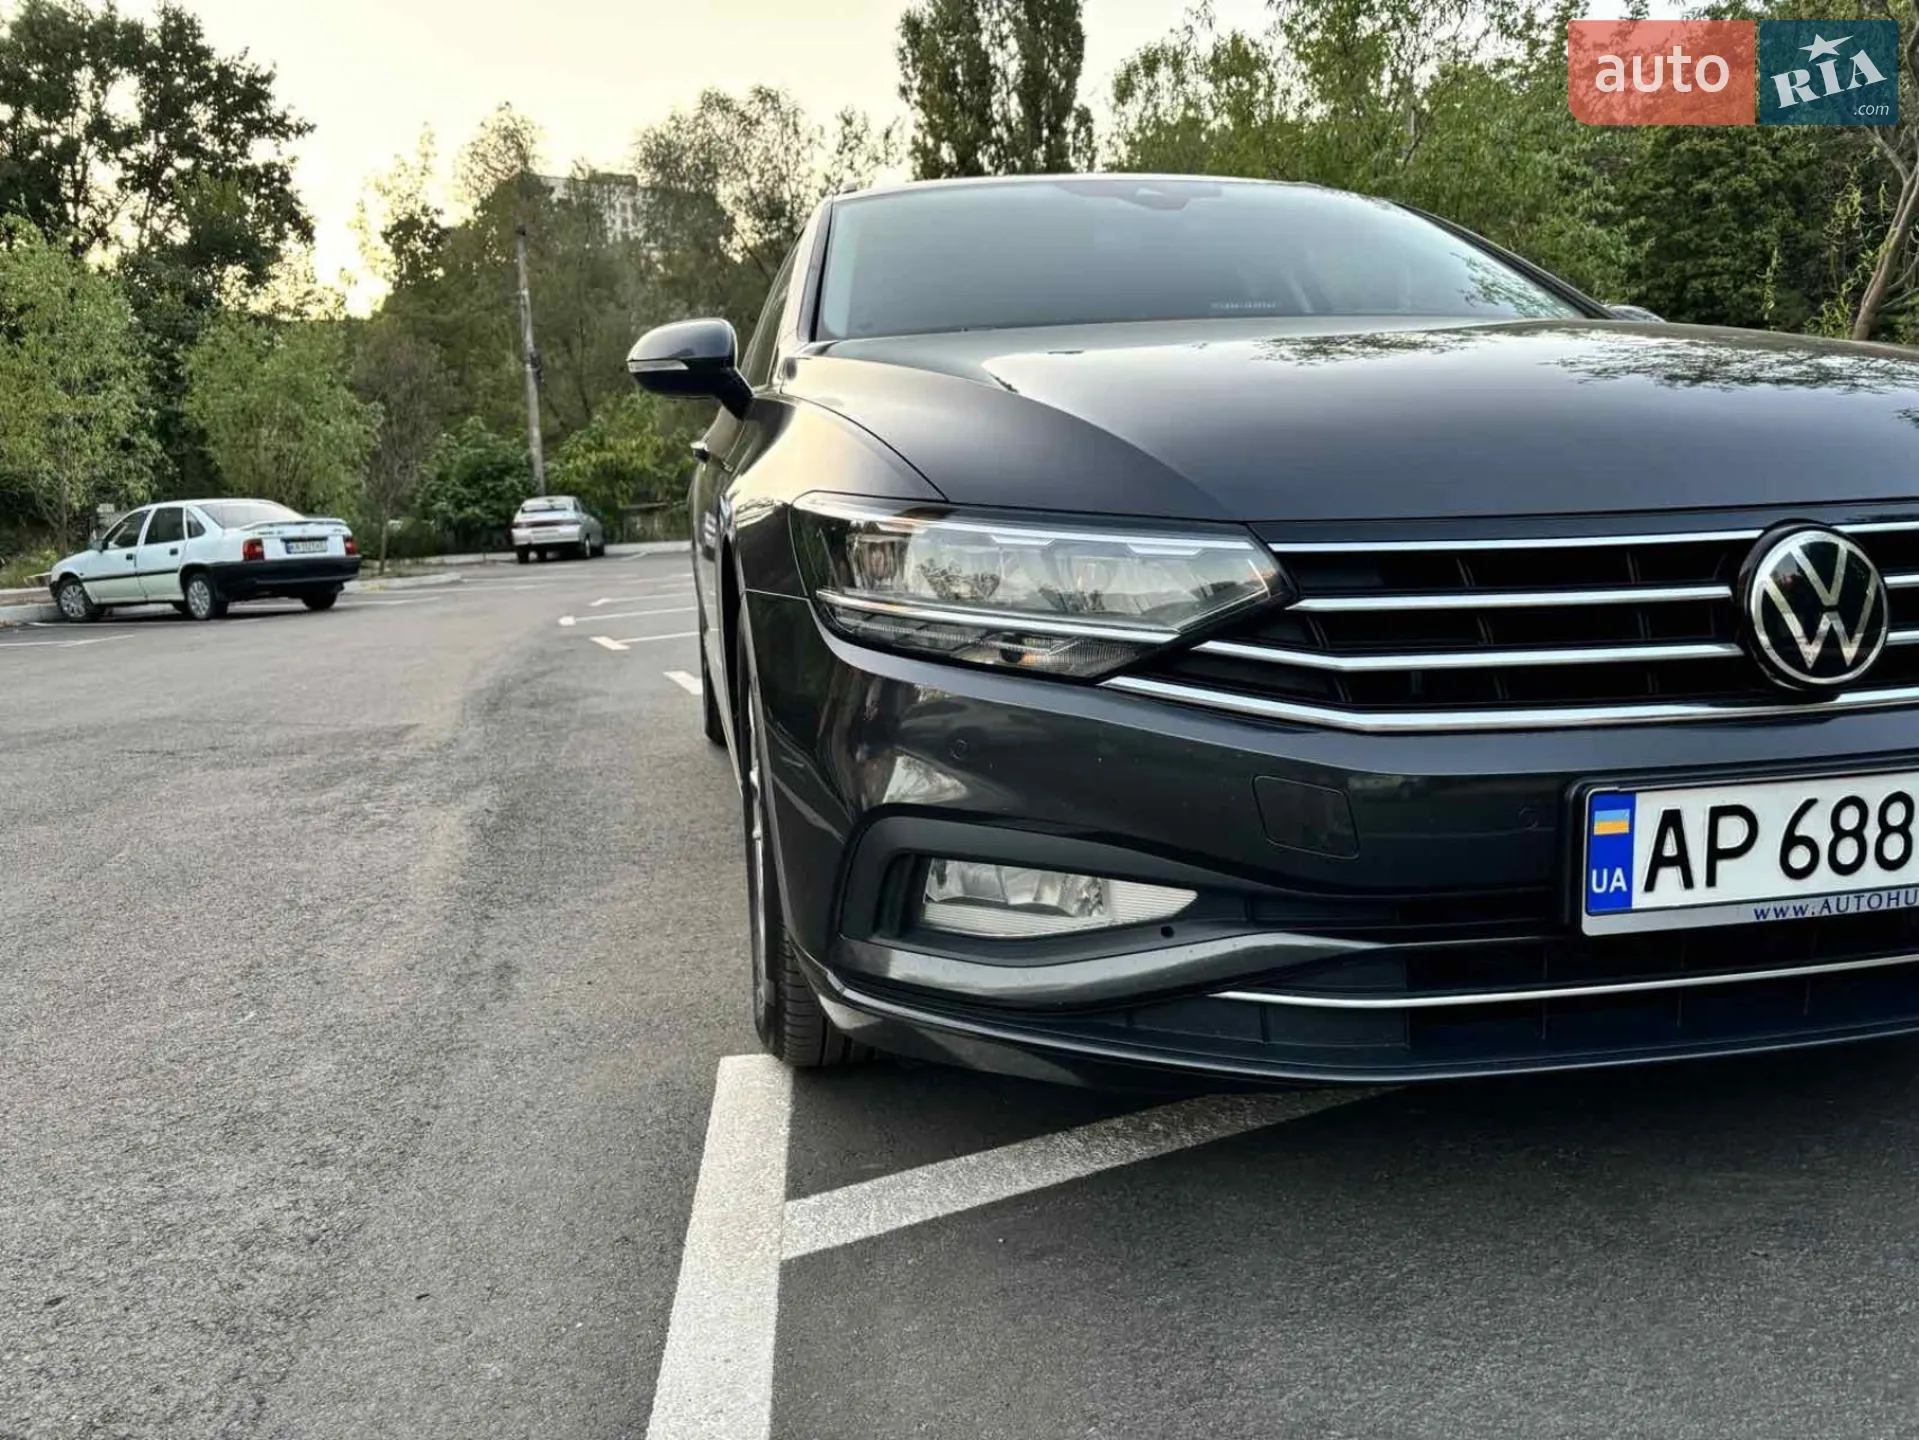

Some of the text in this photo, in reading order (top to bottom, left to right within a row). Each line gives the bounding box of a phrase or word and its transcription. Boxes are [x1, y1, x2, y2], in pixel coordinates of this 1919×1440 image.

[1644, 790, 1916, 893] AP 688
[1592, 867, 1627, 893] UA
